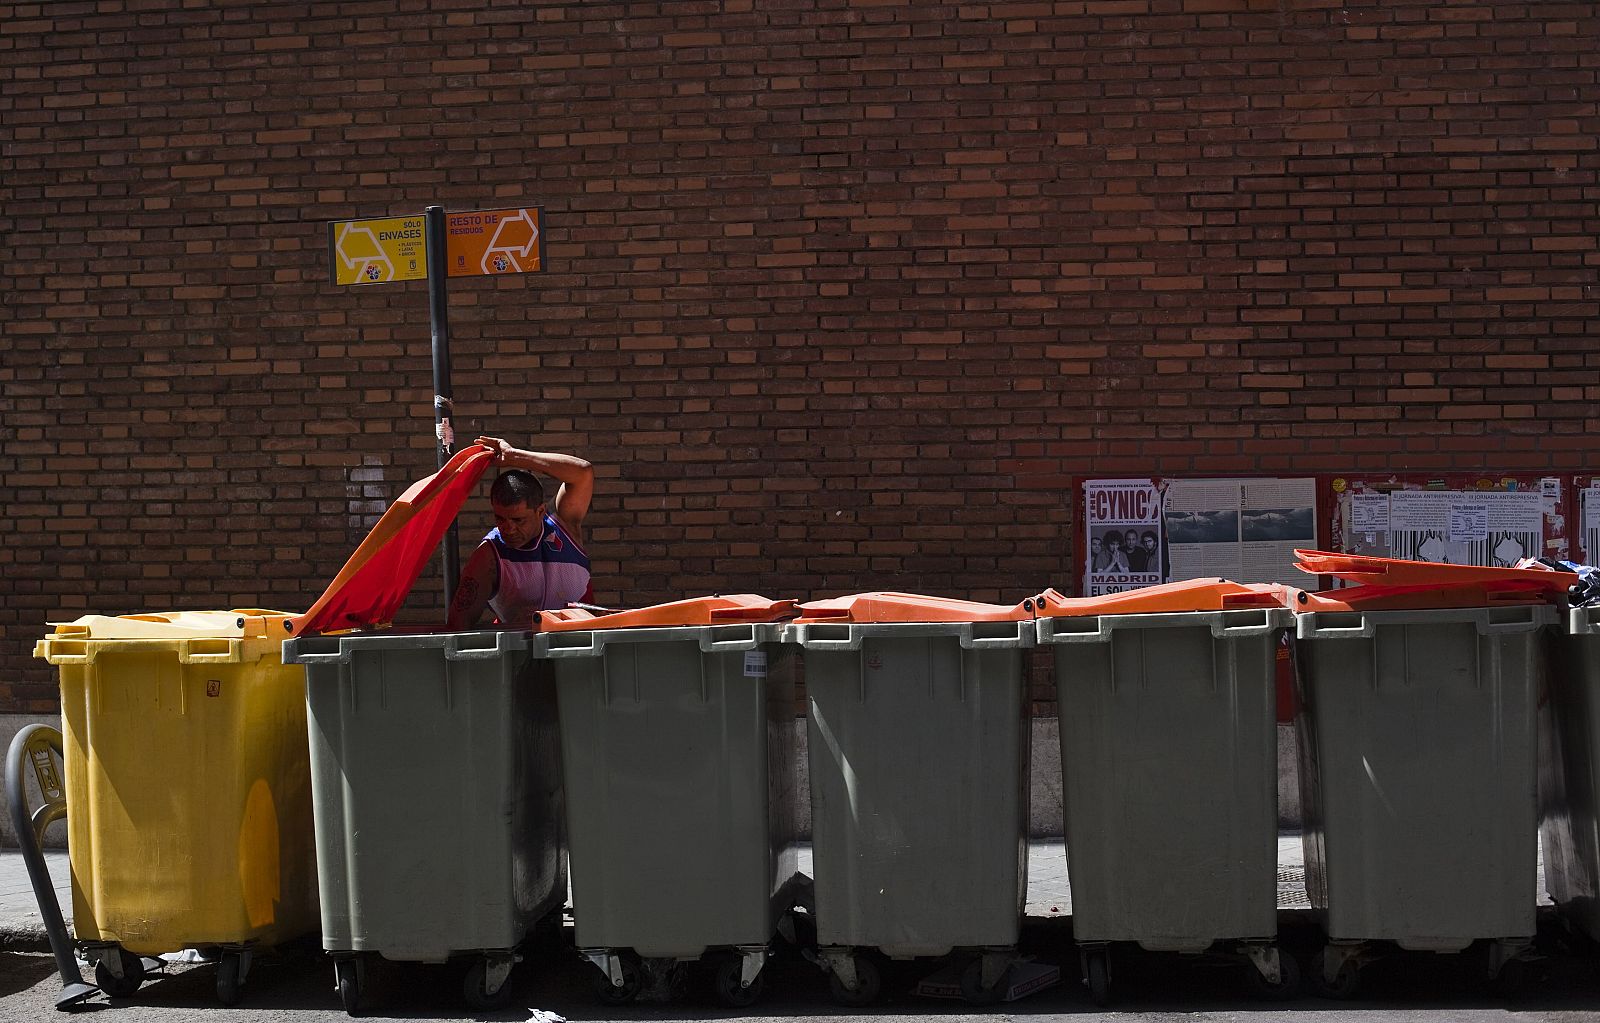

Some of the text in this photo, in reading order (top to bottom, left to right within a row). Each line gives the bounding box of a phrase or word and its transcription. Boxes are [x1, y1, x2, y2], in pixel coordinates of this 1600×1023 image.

[404, 220, 421, 229] SÓLO
[450, 213, 498, 226] RESTO DE
[379, 230, 421, 241] ENVASES
[450, 226, 484, 235] RESIDUOS
[1091, 575, 1160, 583] MADRID
[1091, 586, 1102, 597] EL
